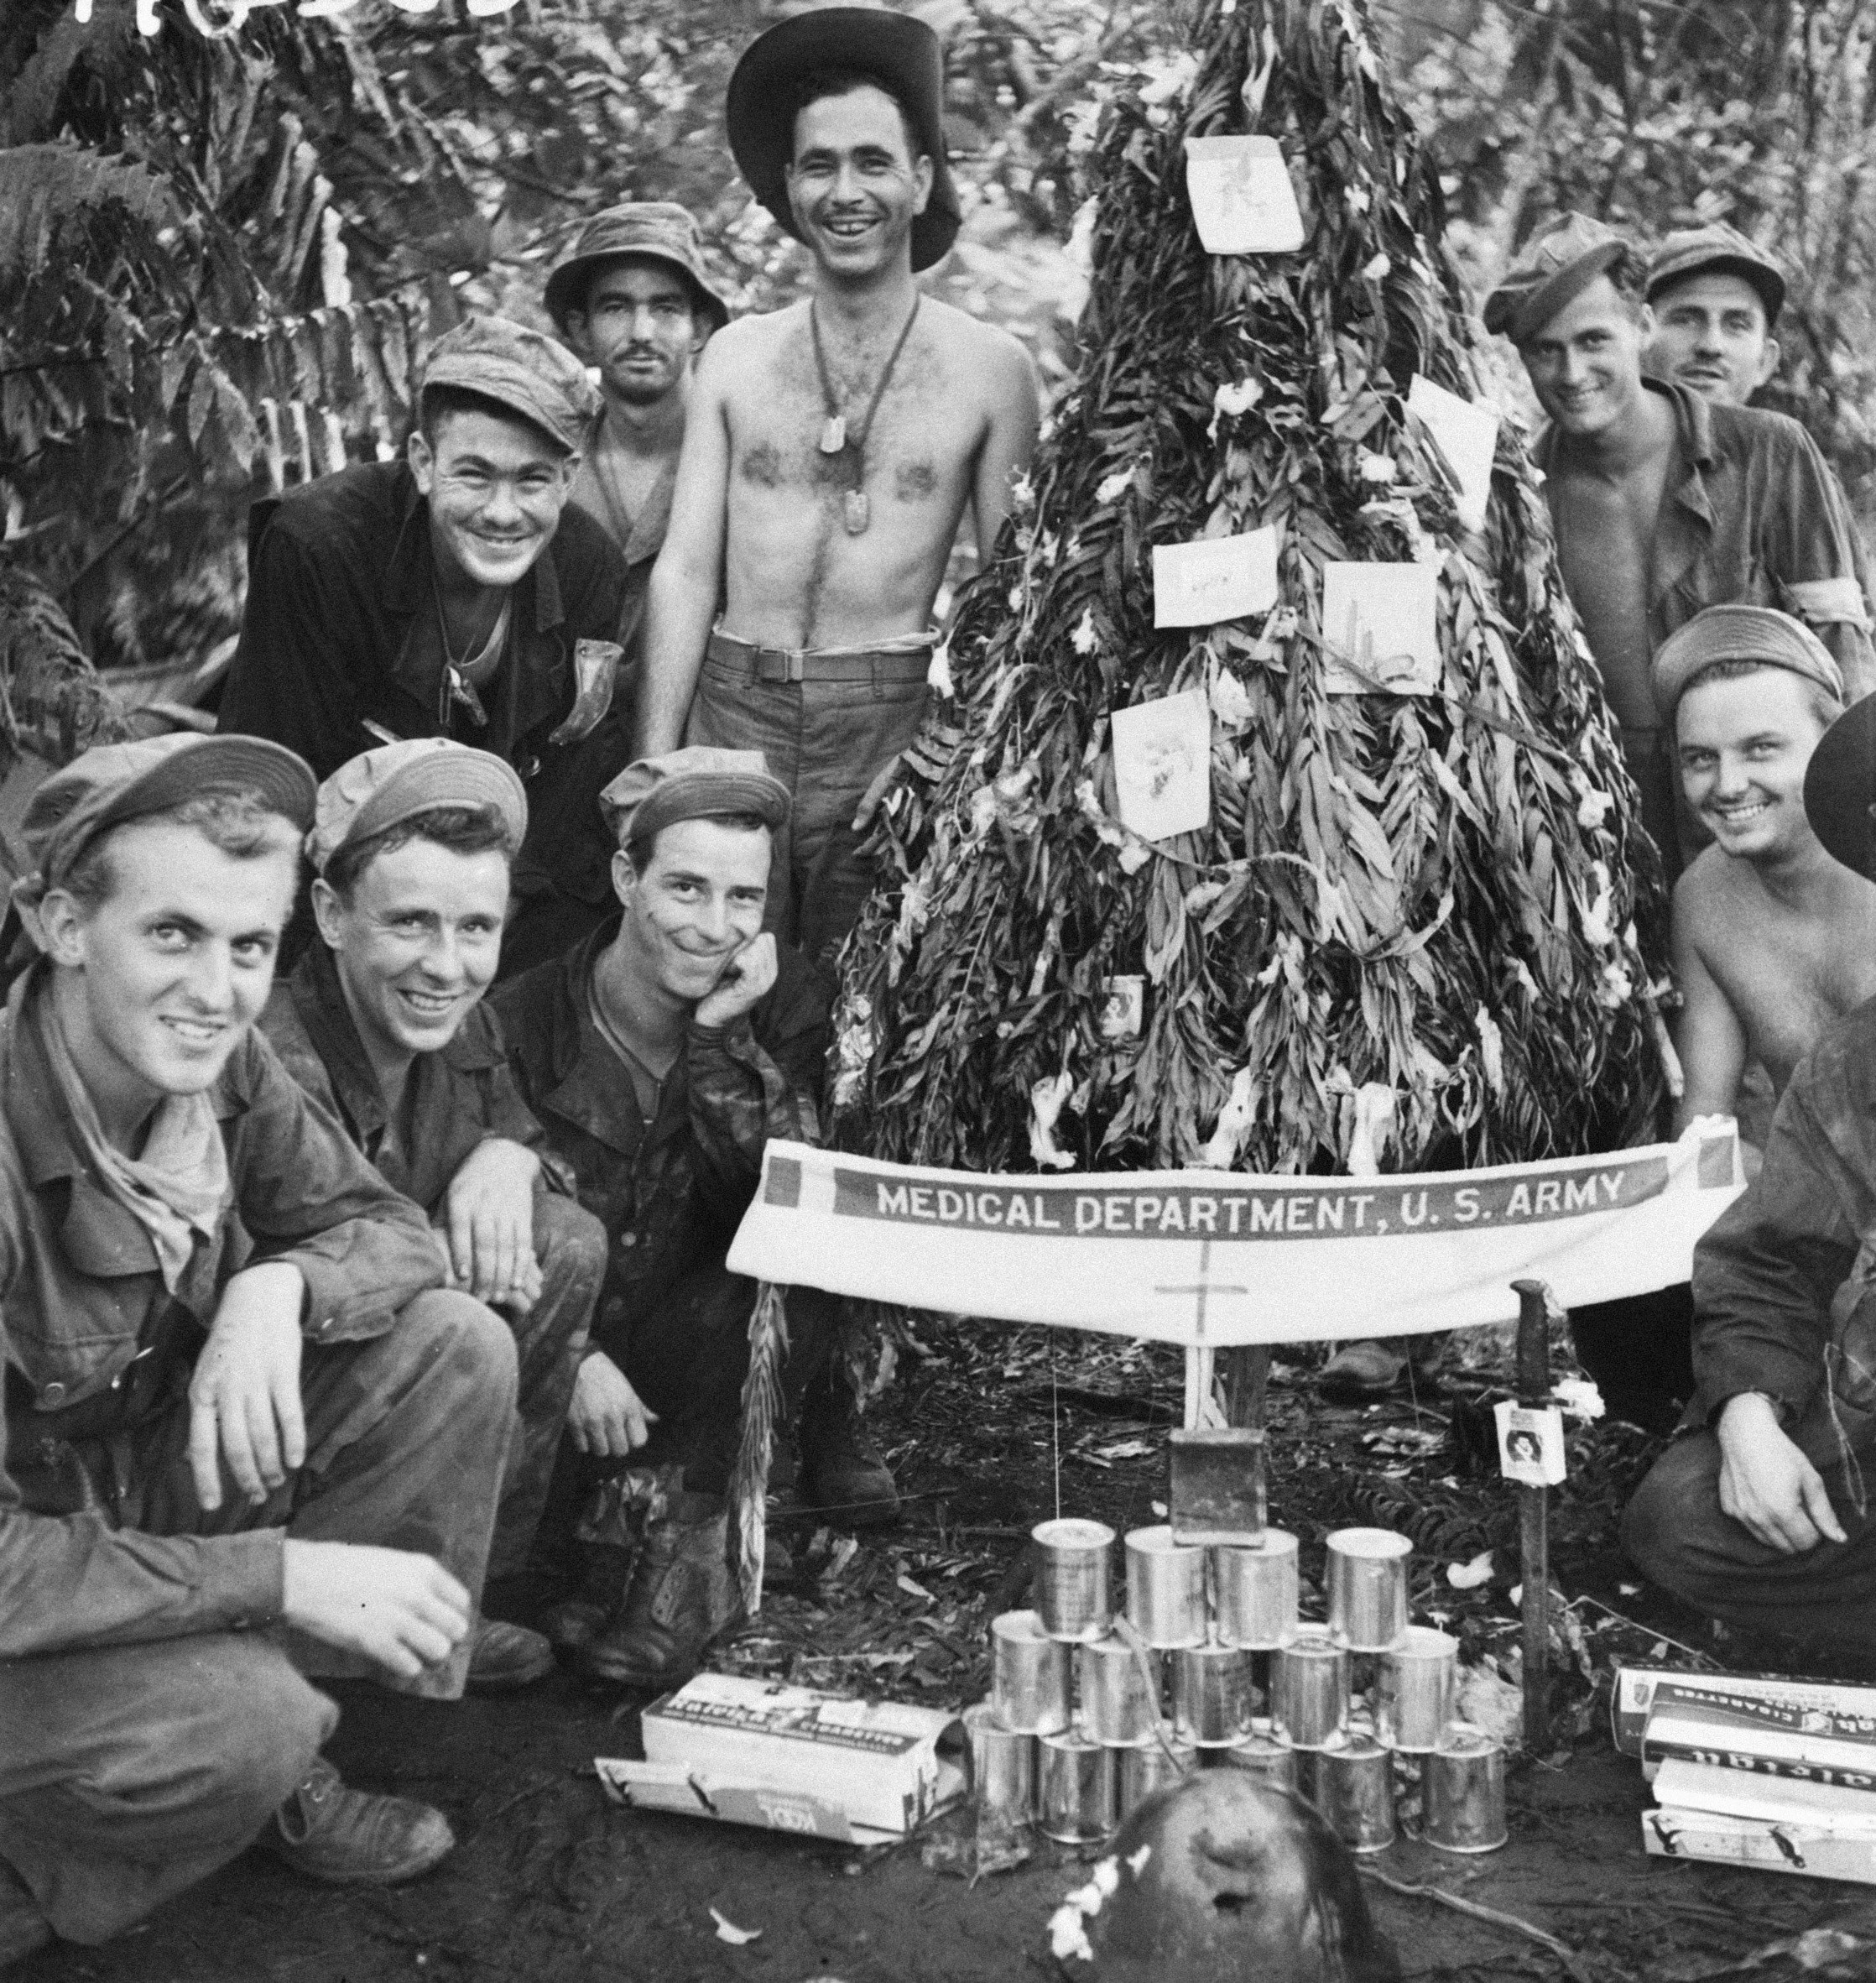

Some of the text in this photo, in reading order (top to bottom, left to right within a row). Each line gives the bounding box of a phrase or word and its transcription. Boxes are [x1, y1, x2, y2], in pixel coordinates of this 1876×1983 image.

[876, 1170, 1626, 1235] MEDICAL DEPARTMENT, U. S. ARMY
